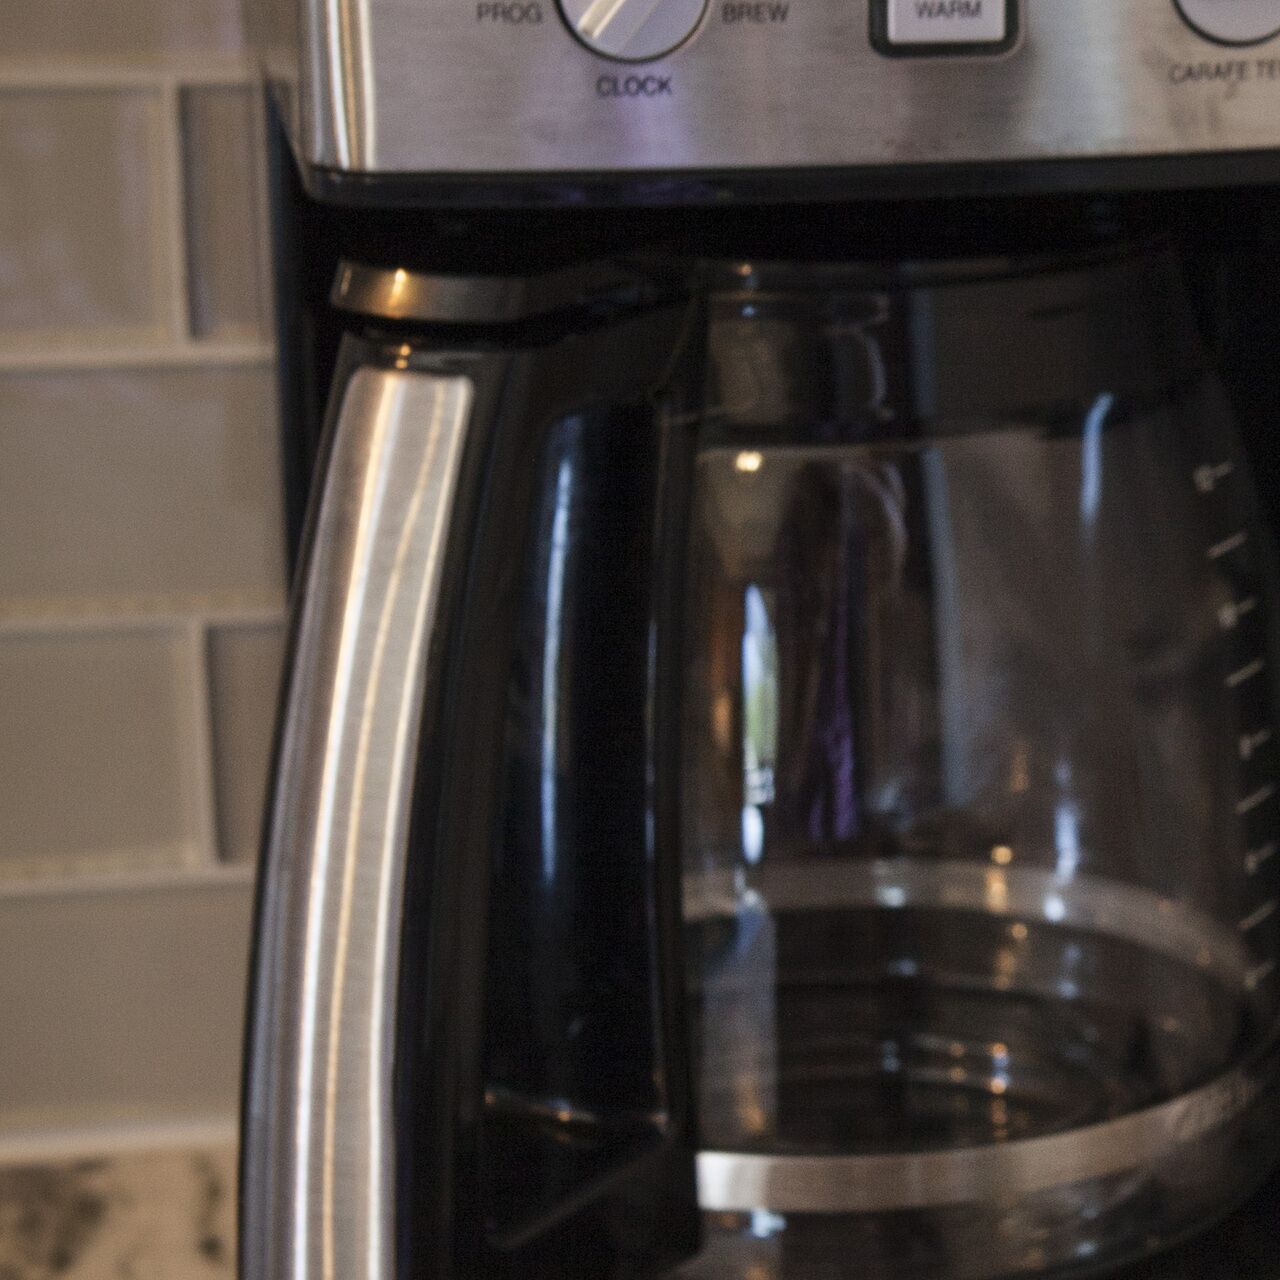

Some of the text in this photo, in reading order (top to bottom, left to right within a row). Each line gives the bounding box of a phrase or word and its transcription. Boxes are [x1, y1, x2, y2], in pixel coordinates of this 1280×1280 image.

[477, 2, 541, 22] PROG
[722, 2, 788, 21] BREW
[915, 0, 981, 19] WARM
[1168, 60, 1248, 84] CARAFE
[597, 75, 671, 97] CLOCK
